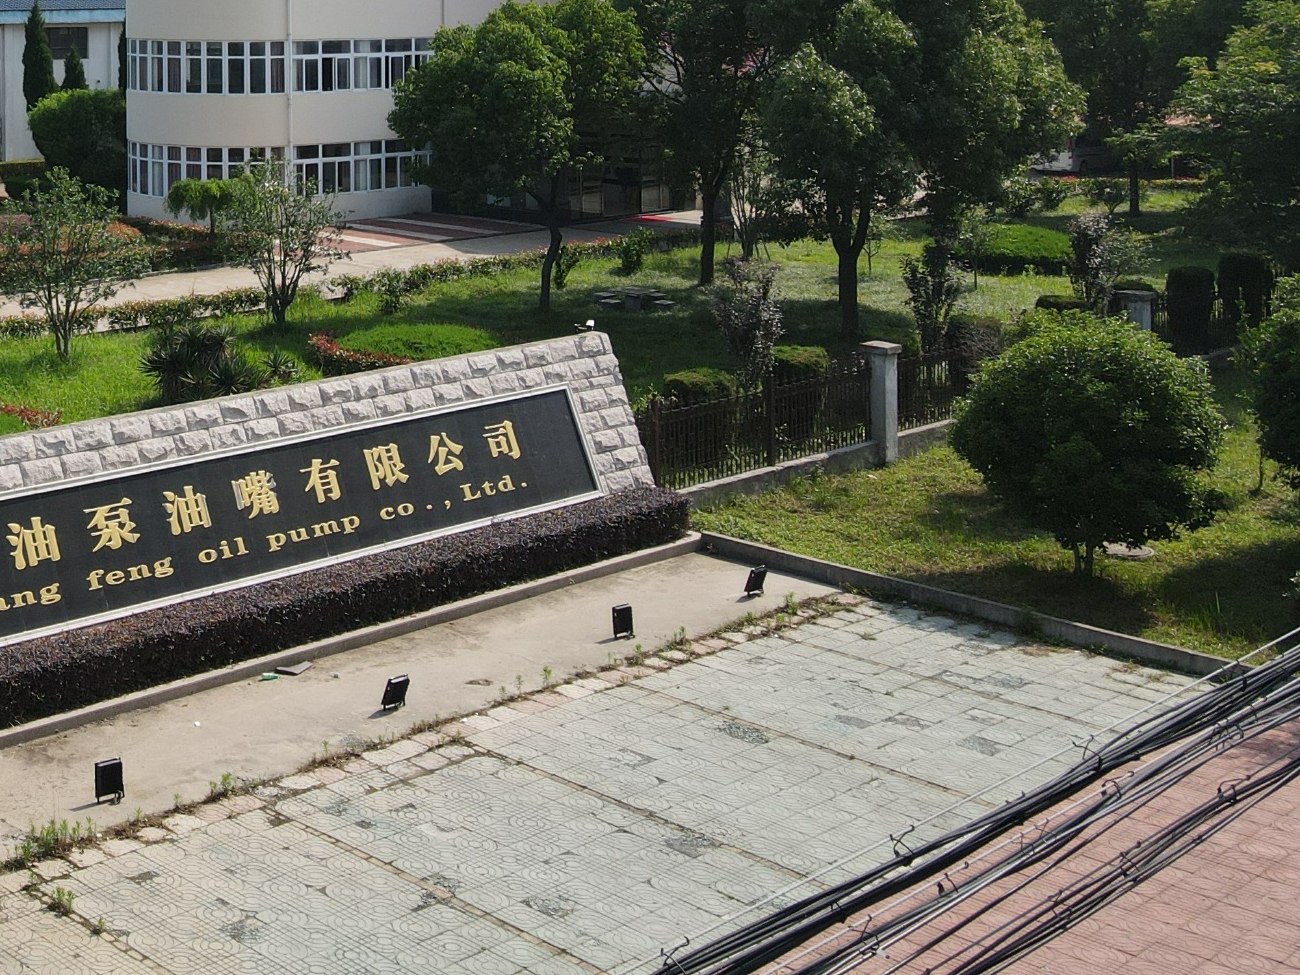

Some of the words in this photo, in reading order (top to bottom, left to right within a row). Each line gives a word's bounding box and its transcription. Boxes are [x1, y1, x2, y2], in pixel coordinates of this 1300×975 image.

[86, 556, 175, 591] feng
[198, 535, 248, 564] oil
[267, 512, 362, 553] pump
[460, 475, 529, 502] Ltd.
